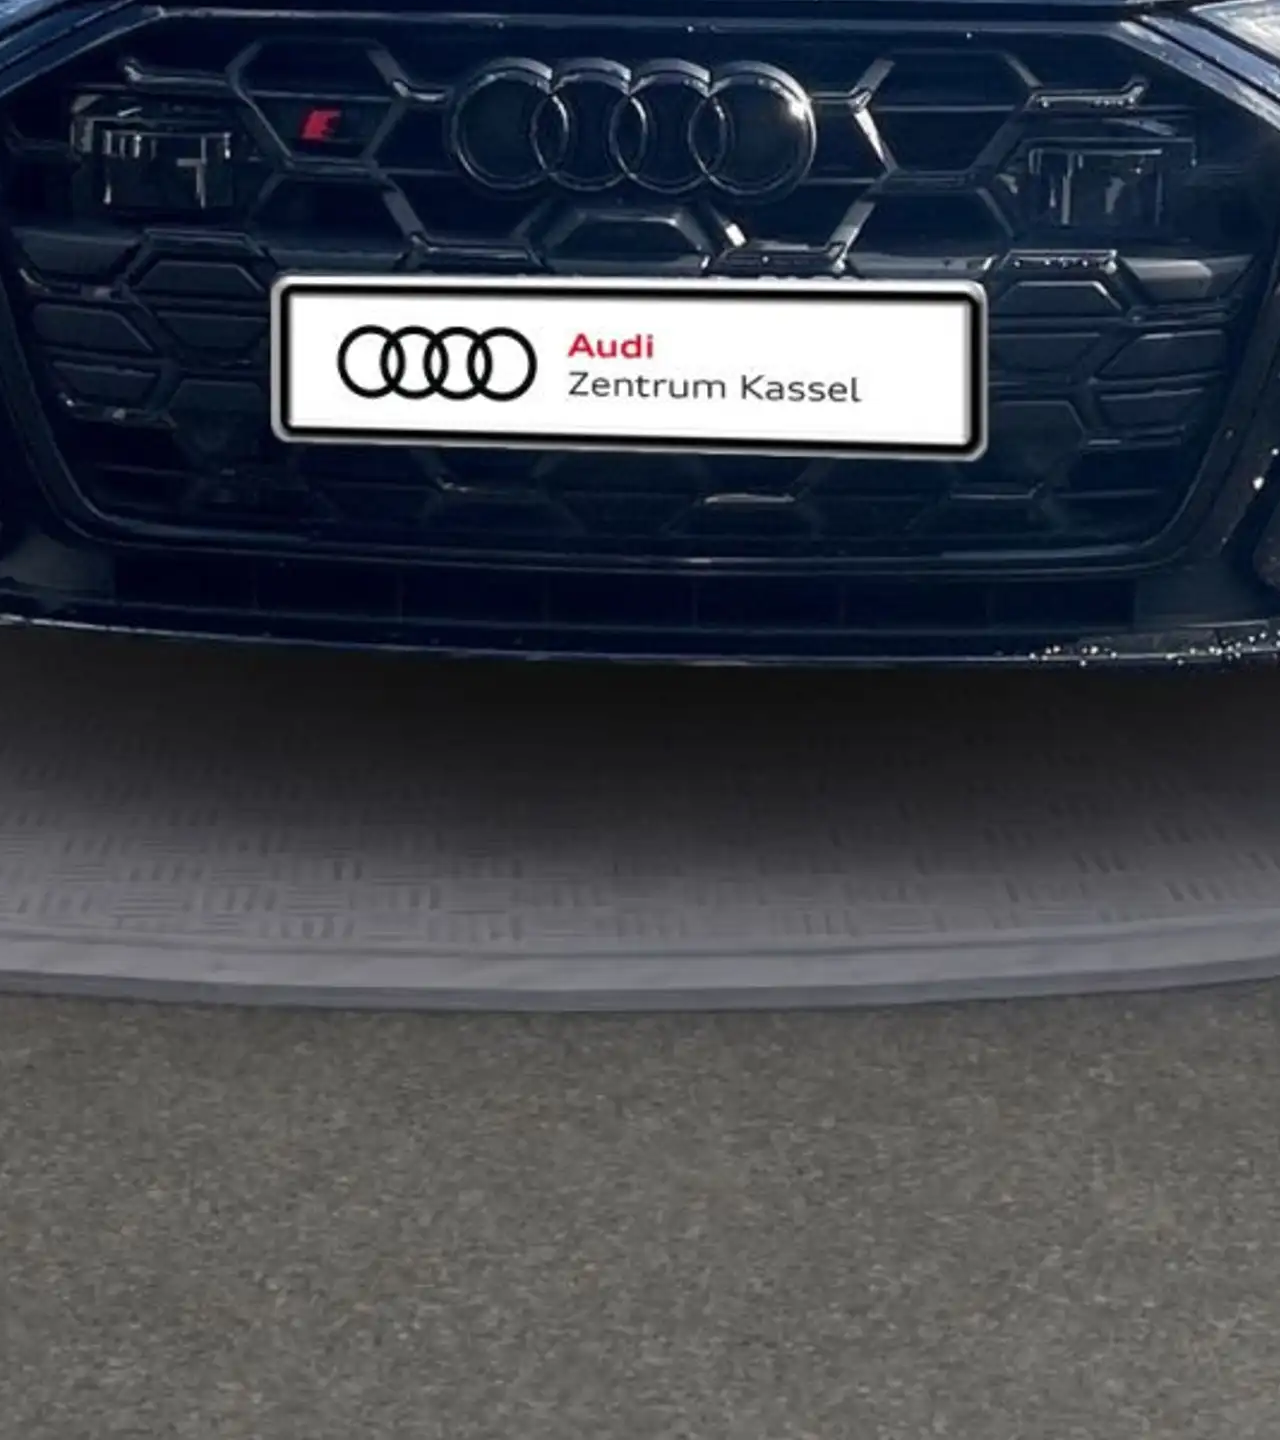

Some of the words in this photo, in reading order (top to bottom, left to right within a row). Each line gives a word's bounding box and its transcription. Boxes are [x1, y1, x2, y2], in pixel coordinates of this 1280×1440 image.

[567, 332, 654, 360] Audi
[568, 370, 726, 400] Zentrum
[740, 374, 862, 403] Kassel
